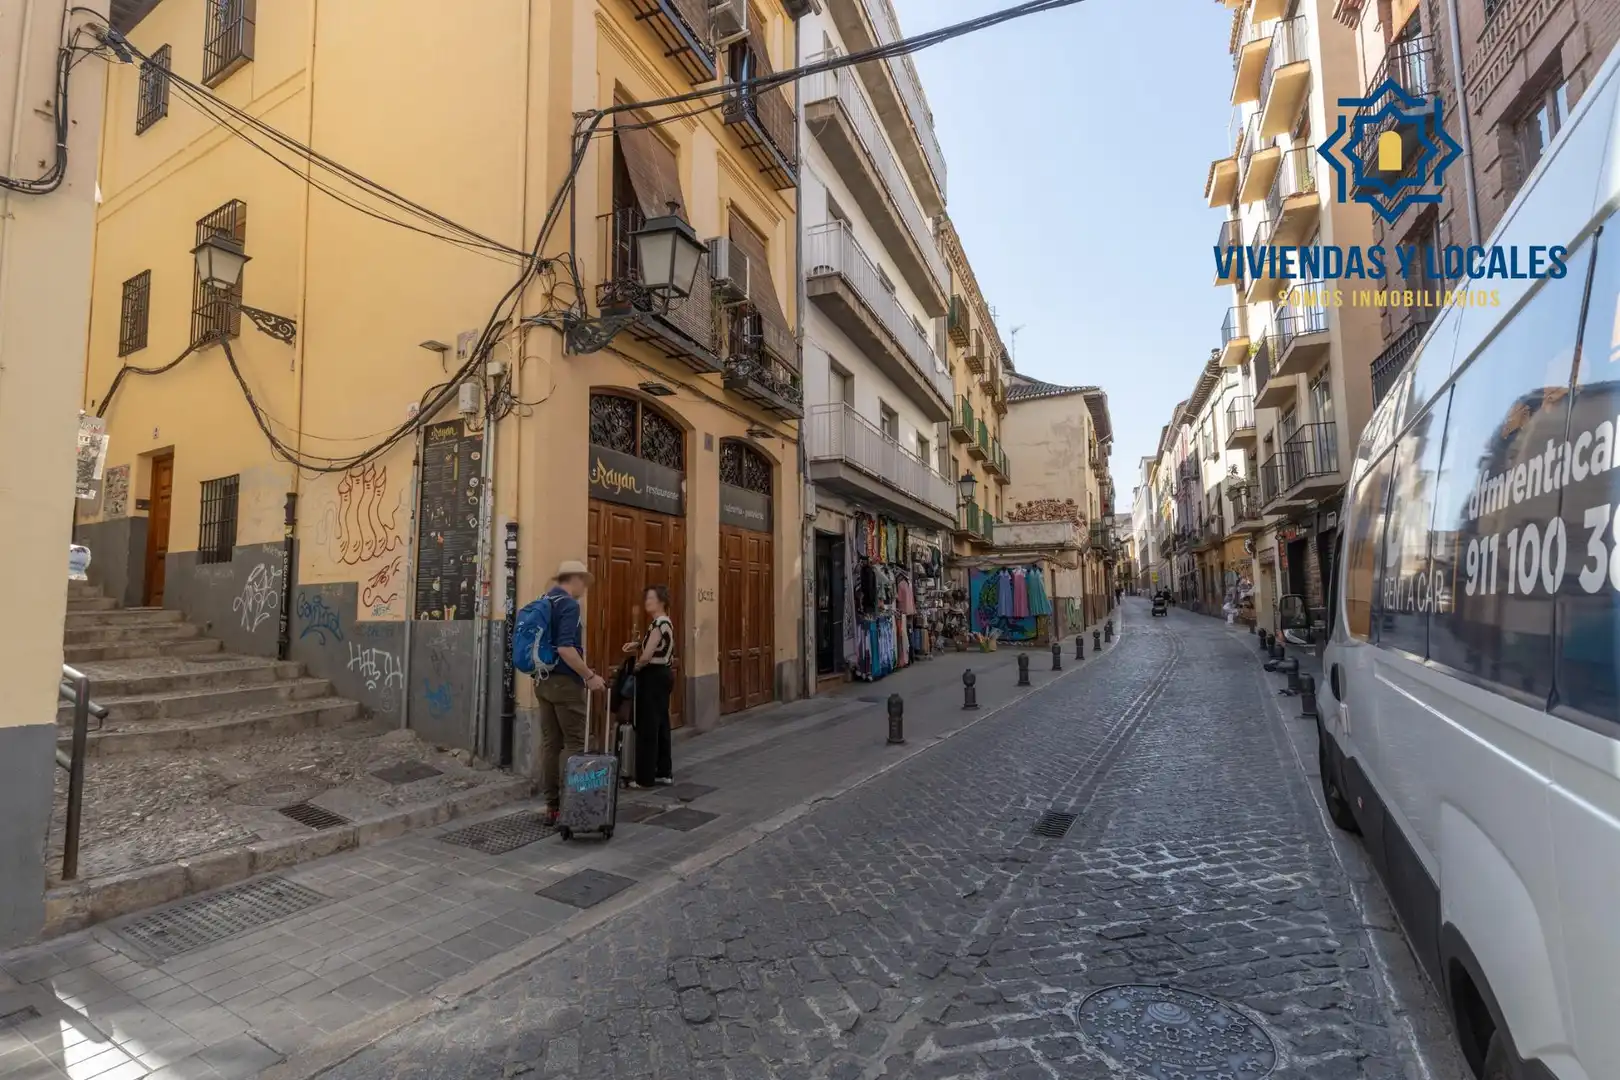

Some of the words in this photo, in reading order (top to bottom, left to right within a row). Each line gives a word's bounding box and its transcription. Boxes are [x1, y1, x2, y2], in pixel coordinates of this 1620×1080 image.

[589, 457, 642, 495] Rayan
[1465, 533, 1500, 596] 911
[1507, 516, 1567, 595] 100
[1384, 576, 1404, 611] RENT
[1406, 575, 1415, 611] A
[1417, 568, 1444, 613] CAR
